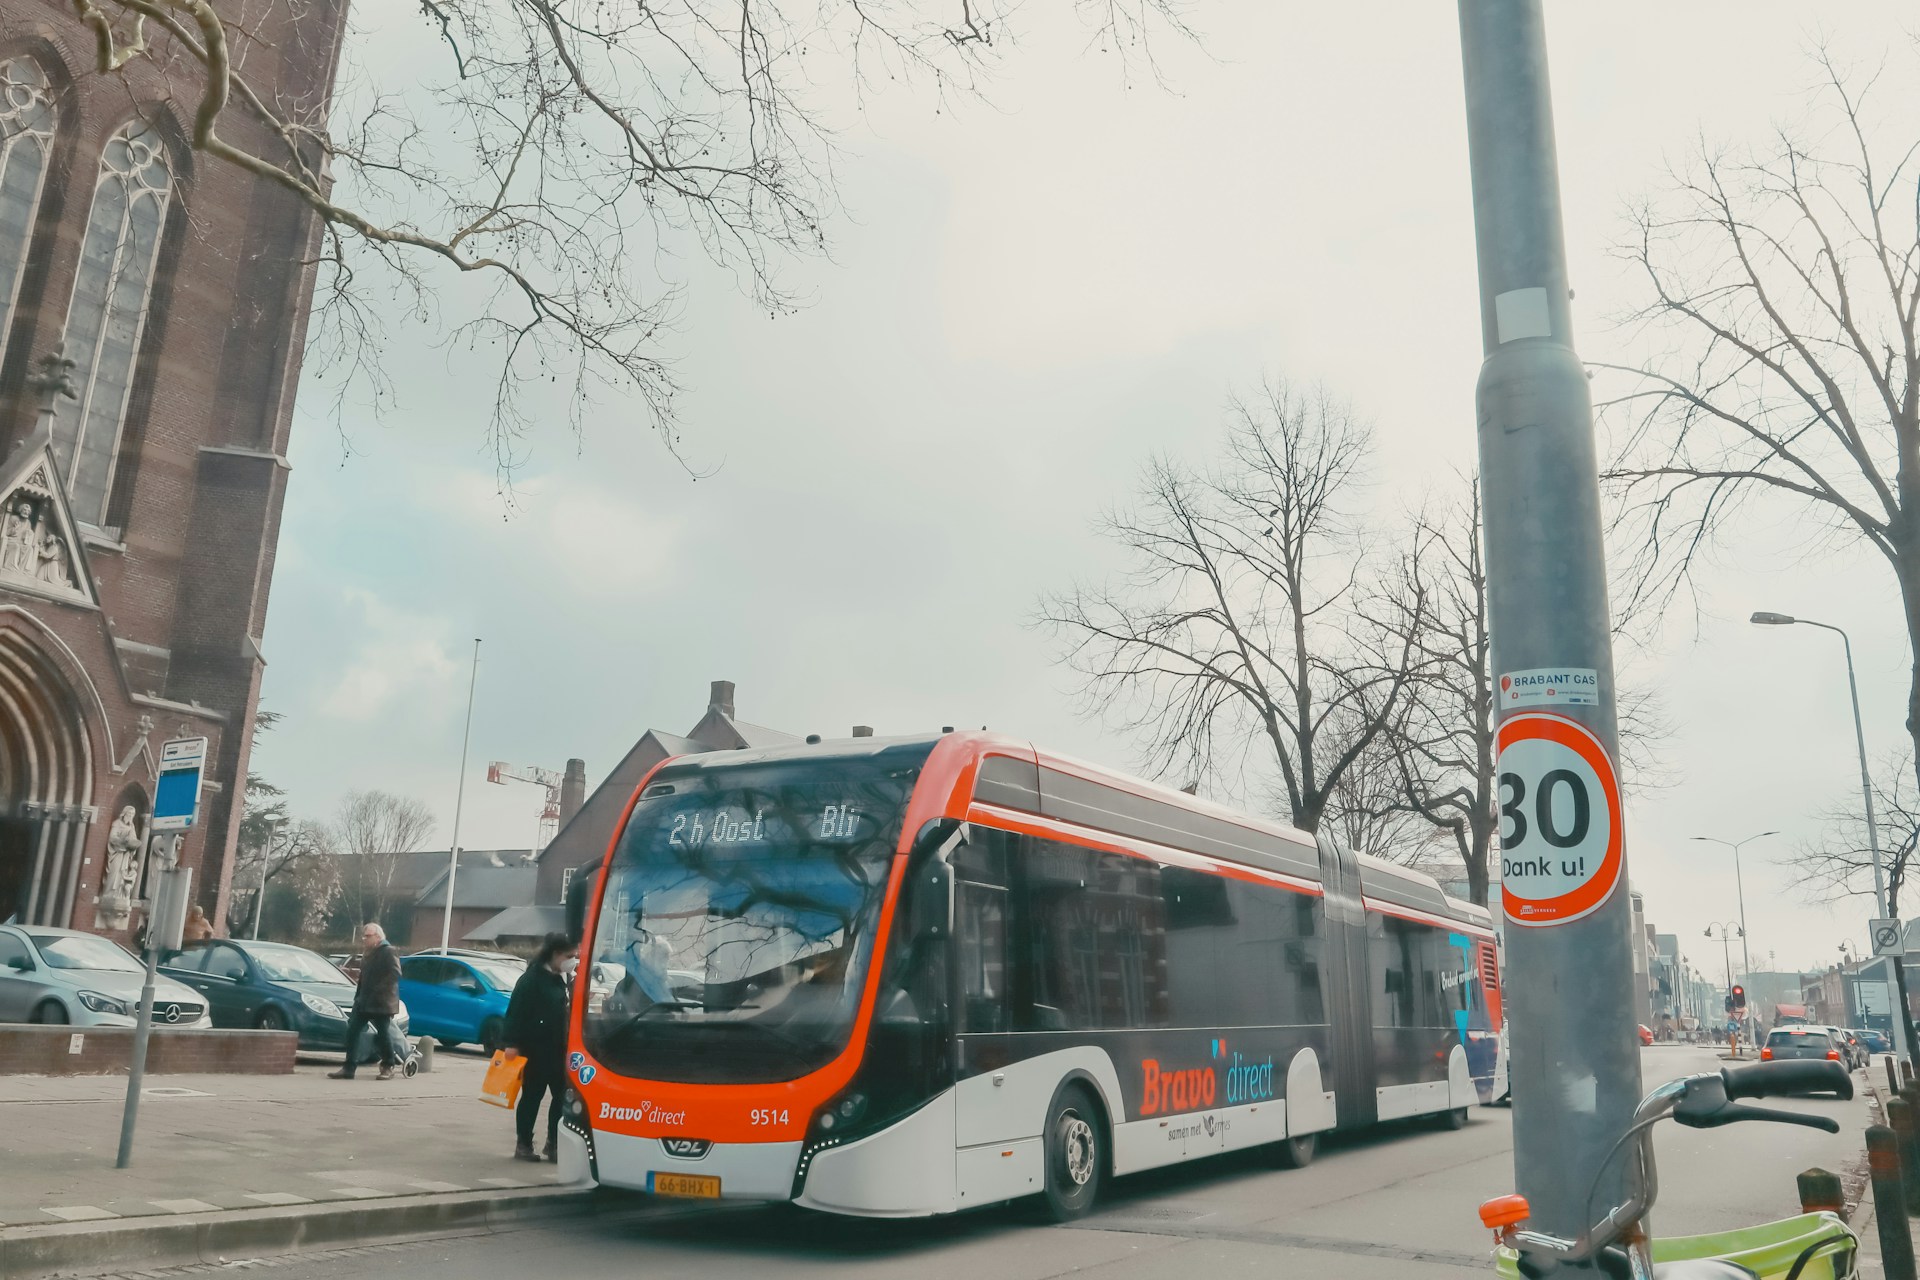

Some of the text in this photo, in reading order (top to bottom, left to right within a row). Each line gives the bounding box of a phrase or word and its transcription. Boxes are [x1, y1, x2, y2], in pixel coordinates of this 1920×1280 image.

[1514, 674, 1596, 687] BRABANT GAS
[1499, 769, 1590, 850] 30
[711, 809, 763, 843] Oost
[820, 804, 860, 838] Bli
[1503, 856, 1585, 877] Dank u!
[1140, 1052, 1273, 1116] Bravo direct
[599, 1102, 686, 1126] Bravo direct
[750, 1109, 790, 1126] 9514
[1168, 1127, 1190, 1142] samen
[666, 1139, 703, 1153] VDL
[659, 1180, 714, 1196] 66-BHX-1
